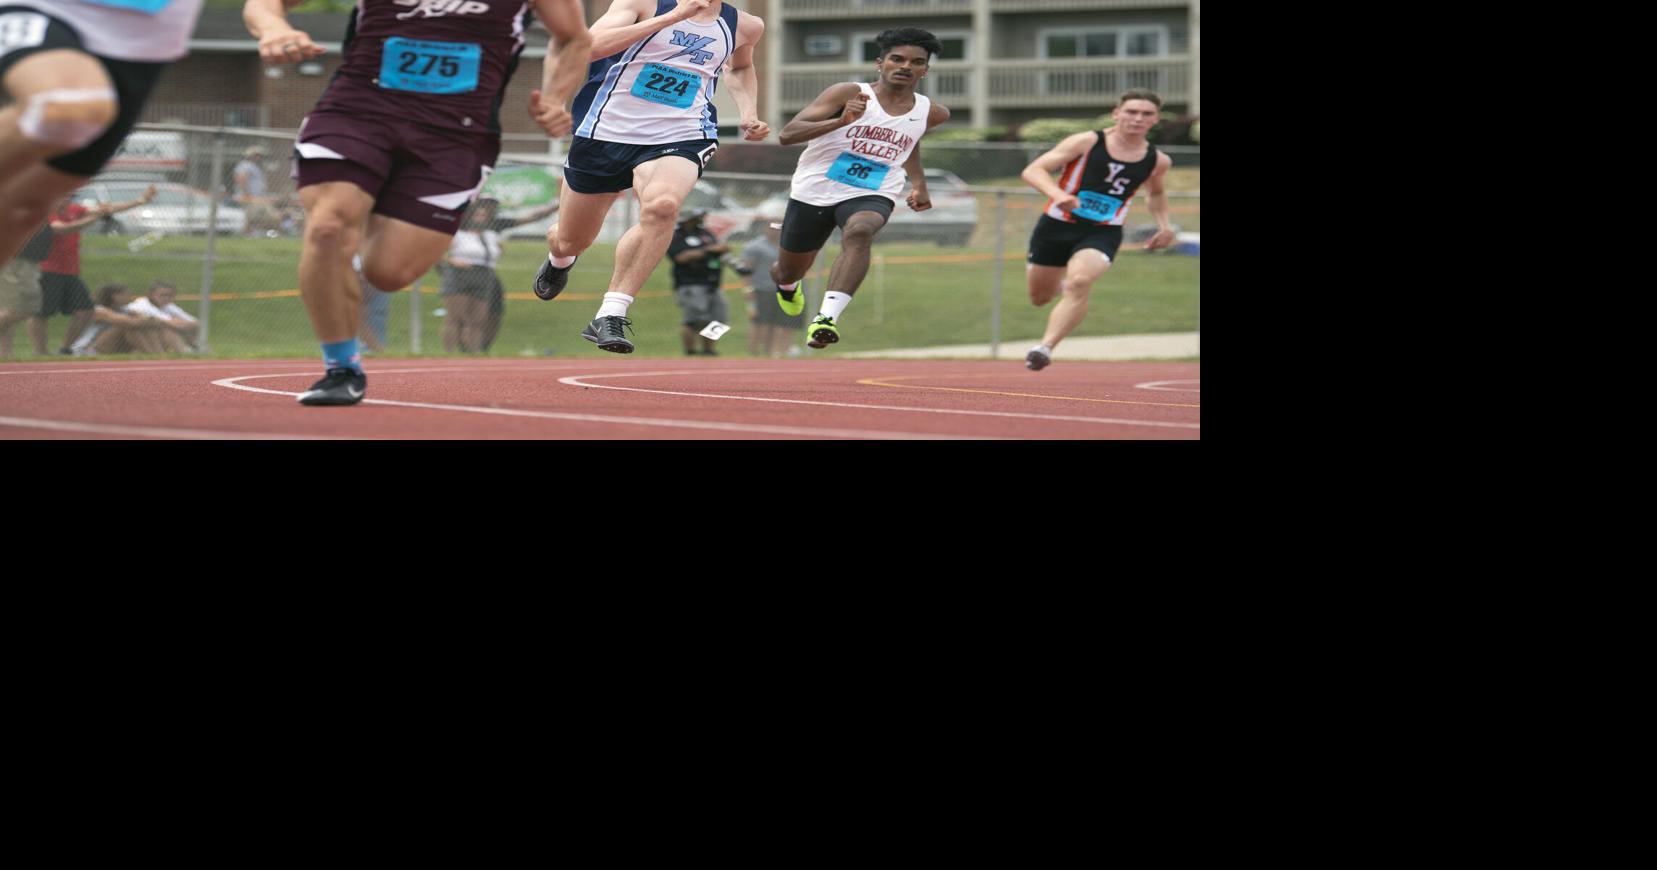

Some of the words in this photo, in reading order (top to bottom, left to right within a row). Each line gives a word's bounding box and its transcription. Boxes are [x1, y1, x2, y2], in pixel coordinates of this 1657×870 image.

[398, 51, 461, 78] 275
[644, 72, 690, 97] 224
[851, 139, 902, 161] VALLEY
[846, 162, 873, 180] 86
